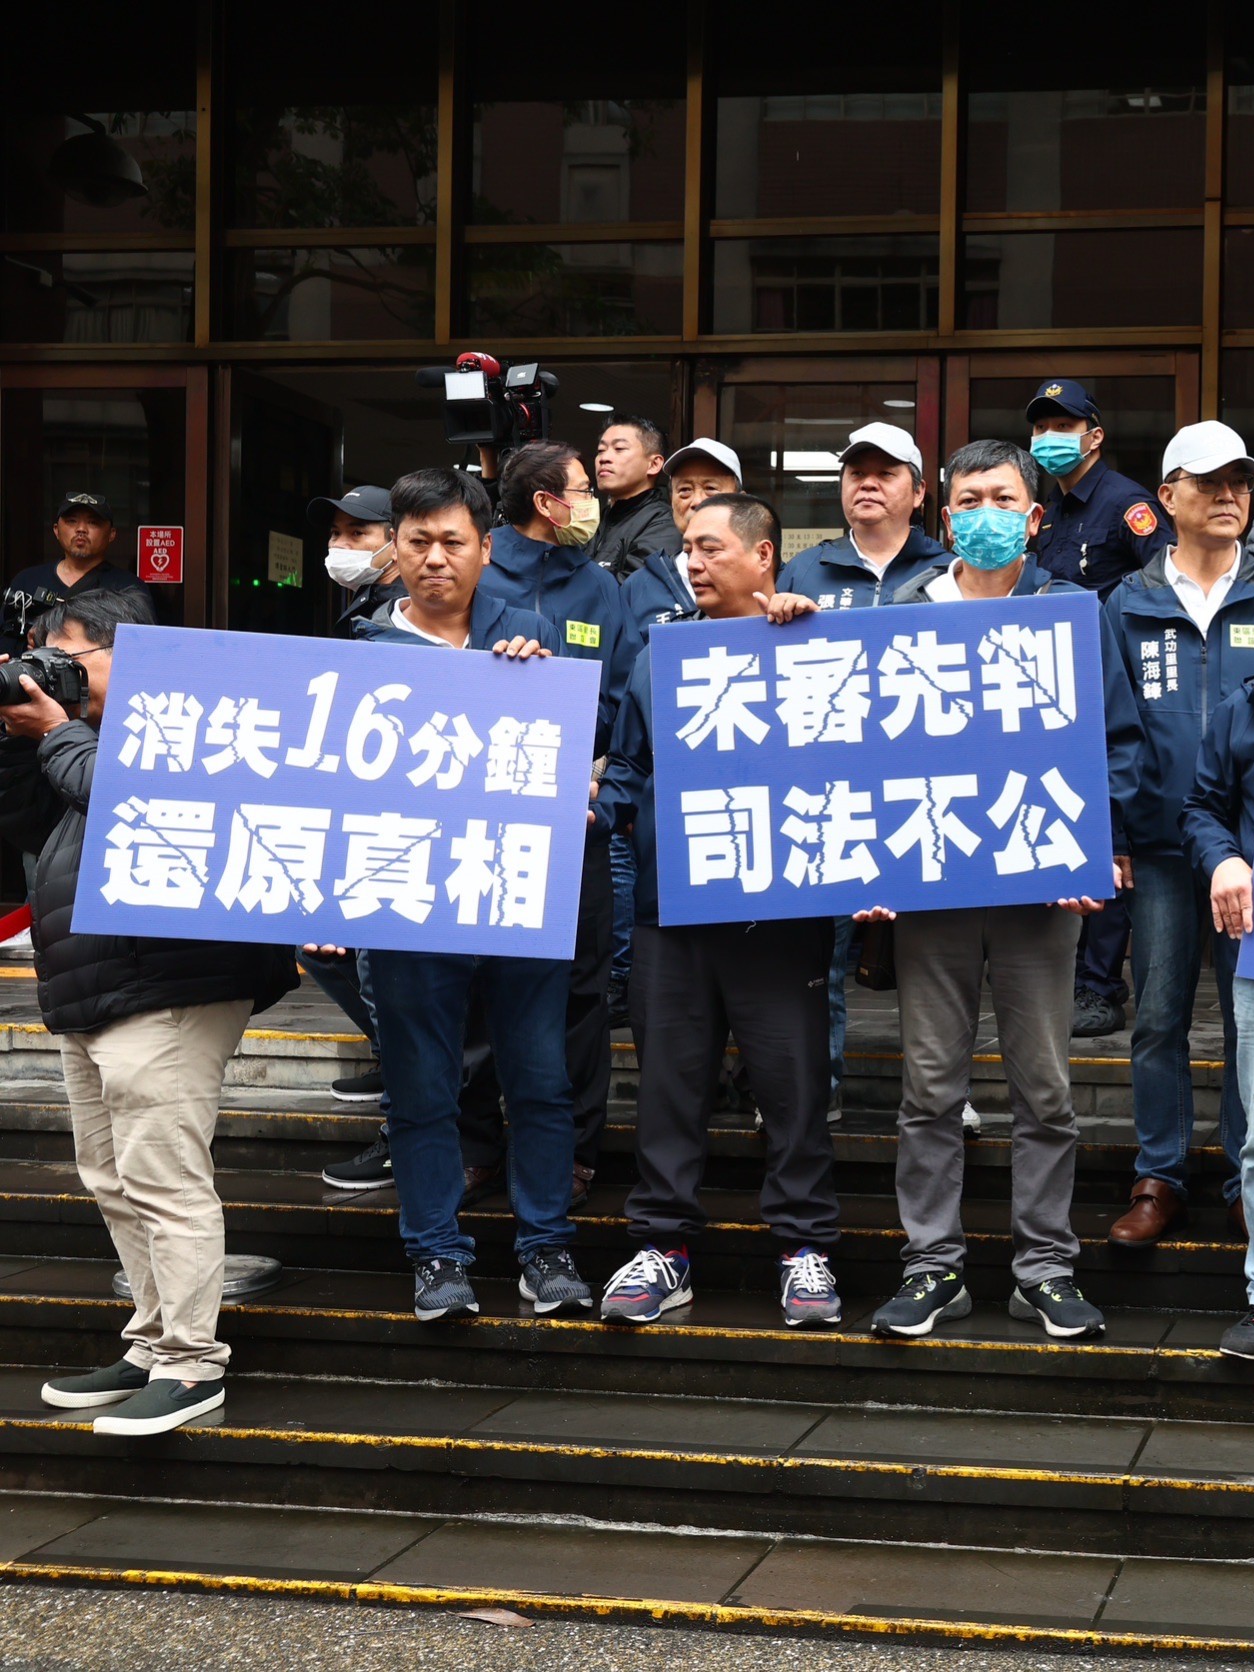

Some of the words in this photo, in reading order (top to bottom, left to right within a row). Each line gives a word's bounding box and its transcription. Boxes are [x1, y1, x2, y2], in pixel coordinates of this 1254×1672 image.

[145, 538, 176, 547] 設置AED
[149, 530, 172, 539] 本場所
[153, 547, 168, 555] AED
[839, 587, 854, 610] 文華
[676, 622, 1076, 752] 未審先判
[1164, 628, 1178, 692] 武功里里長
[118, 671, 561, 797] 消失16分鐘
[100, 796, 552, 929] 還原真相
[681, 768, 1088, 893] 司法不公
